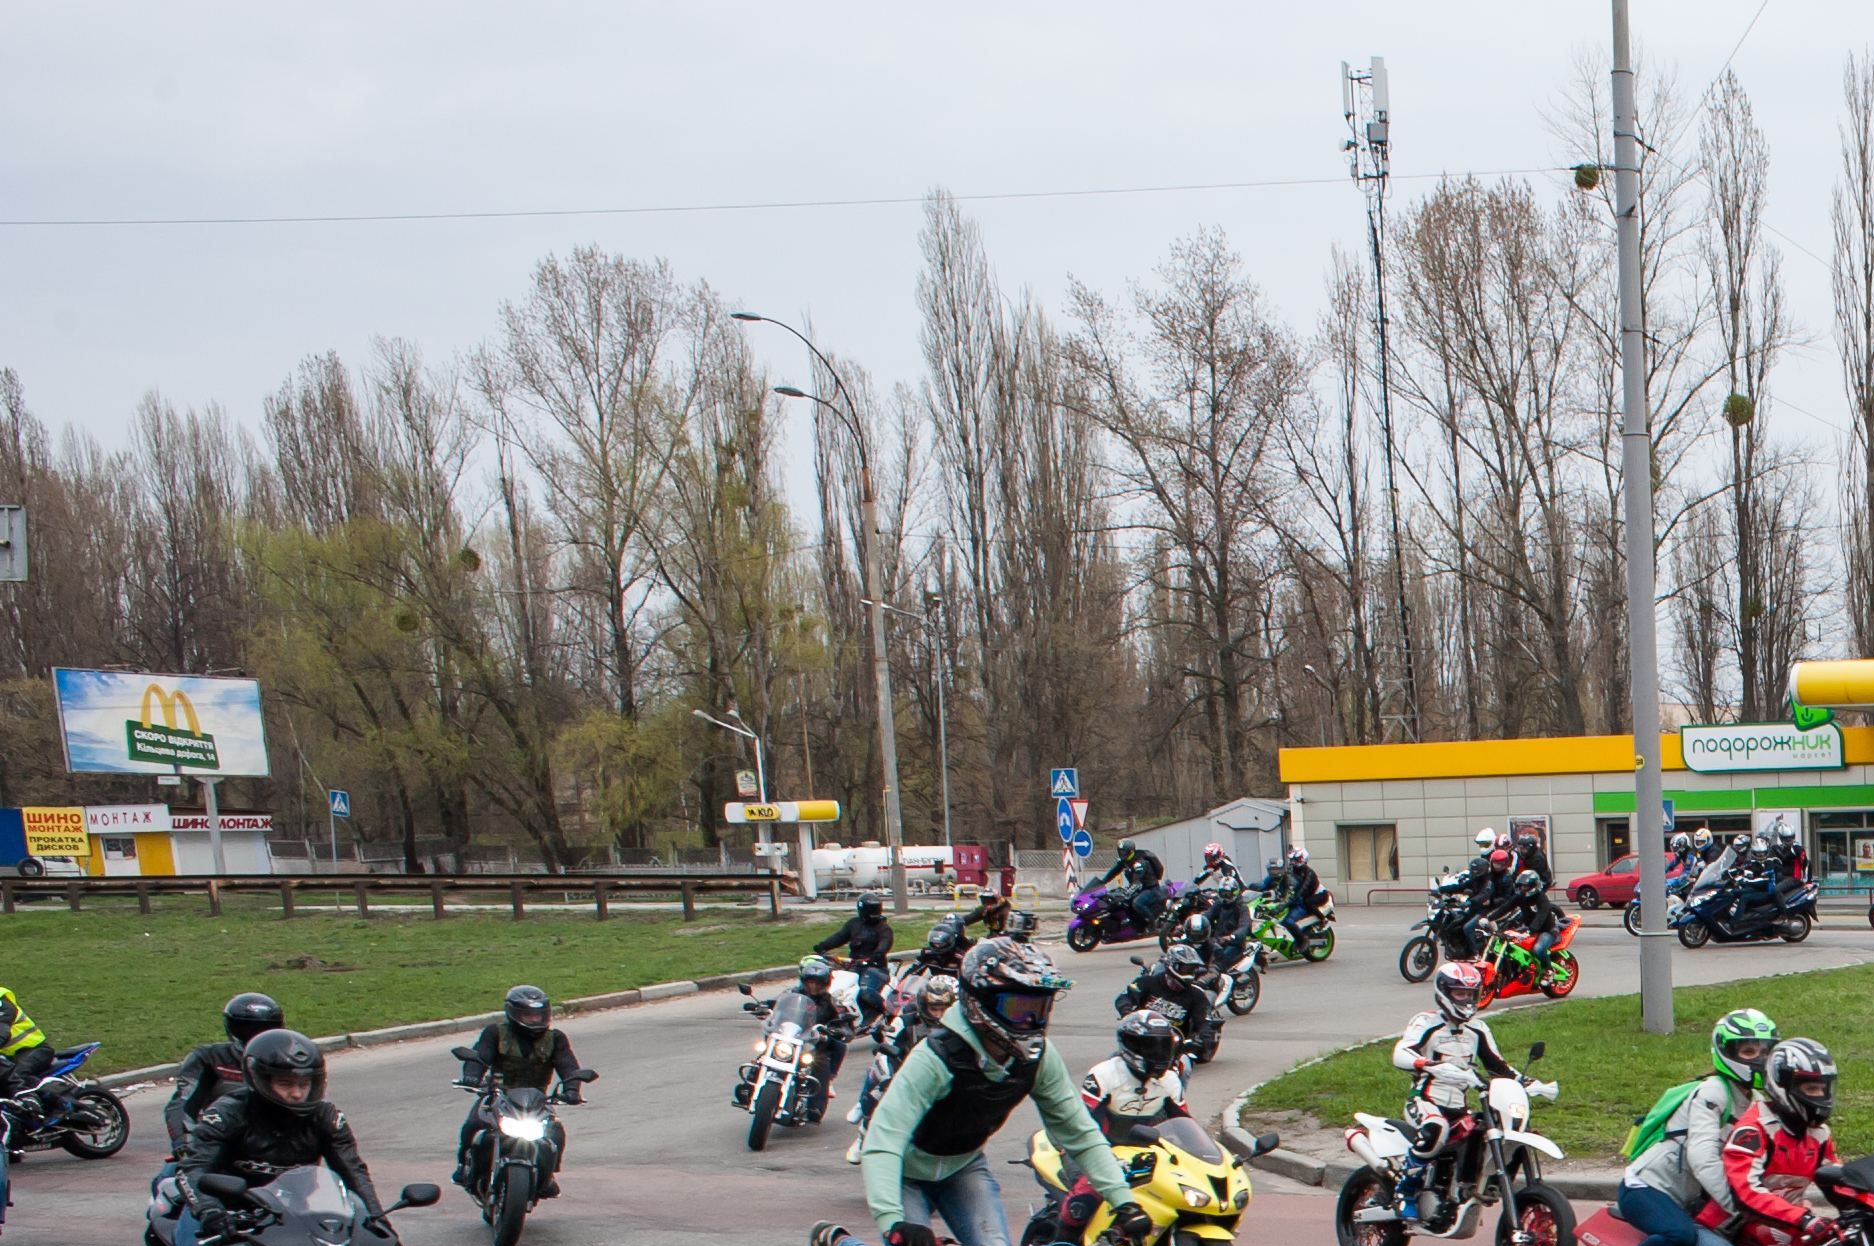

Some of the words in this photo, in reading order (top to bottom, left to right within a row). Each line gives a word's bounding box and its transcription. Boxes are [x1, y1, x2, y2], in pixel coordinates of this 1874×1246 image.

[133, 729, 167, 743] СКОРО
[26, 813, 81, 824] ШИНО
[89, 811, 152, 827] МОНТАЖ
[28, 824, 83, 833] МОНТАЖ
[36, 844, 80, 852] ДИСКОВ
